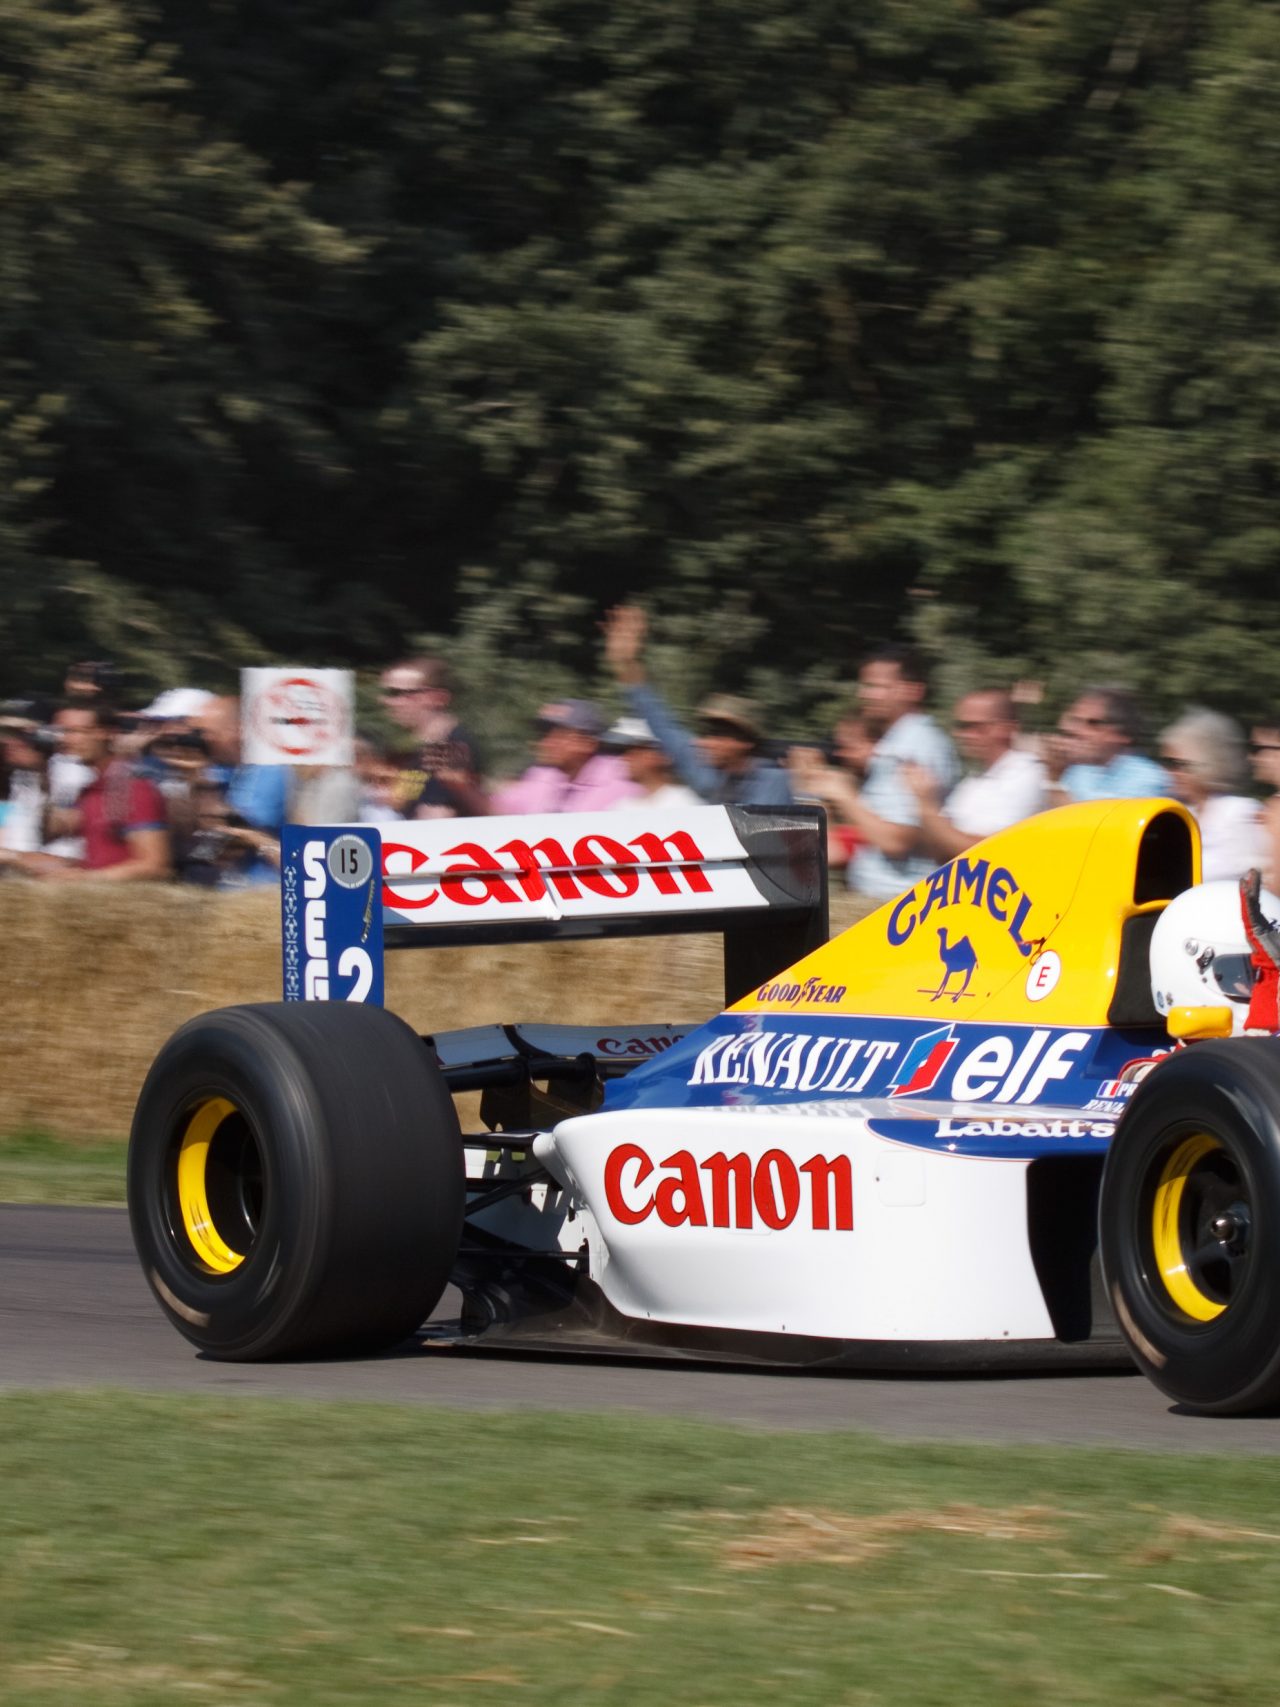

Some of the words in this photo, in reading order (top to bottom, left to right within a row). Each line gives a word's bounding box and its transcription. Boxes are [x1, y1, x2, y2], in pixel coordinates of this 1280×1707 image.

[341, 848, 358, 874] 15
[381, 830, 713, 909] Canon
[887, 857, 1033, 957] CAMEL
[338, 946, 373, 1002] 2
[1036, 966, 1051, 987] E
[687, 1031, 899, 1093] RENAULT
[951, 1030, 1092, 1104] elf
[935, 1118, 1116, 1138] Labatt's
[604, 1143, 854, 1231] Canon
